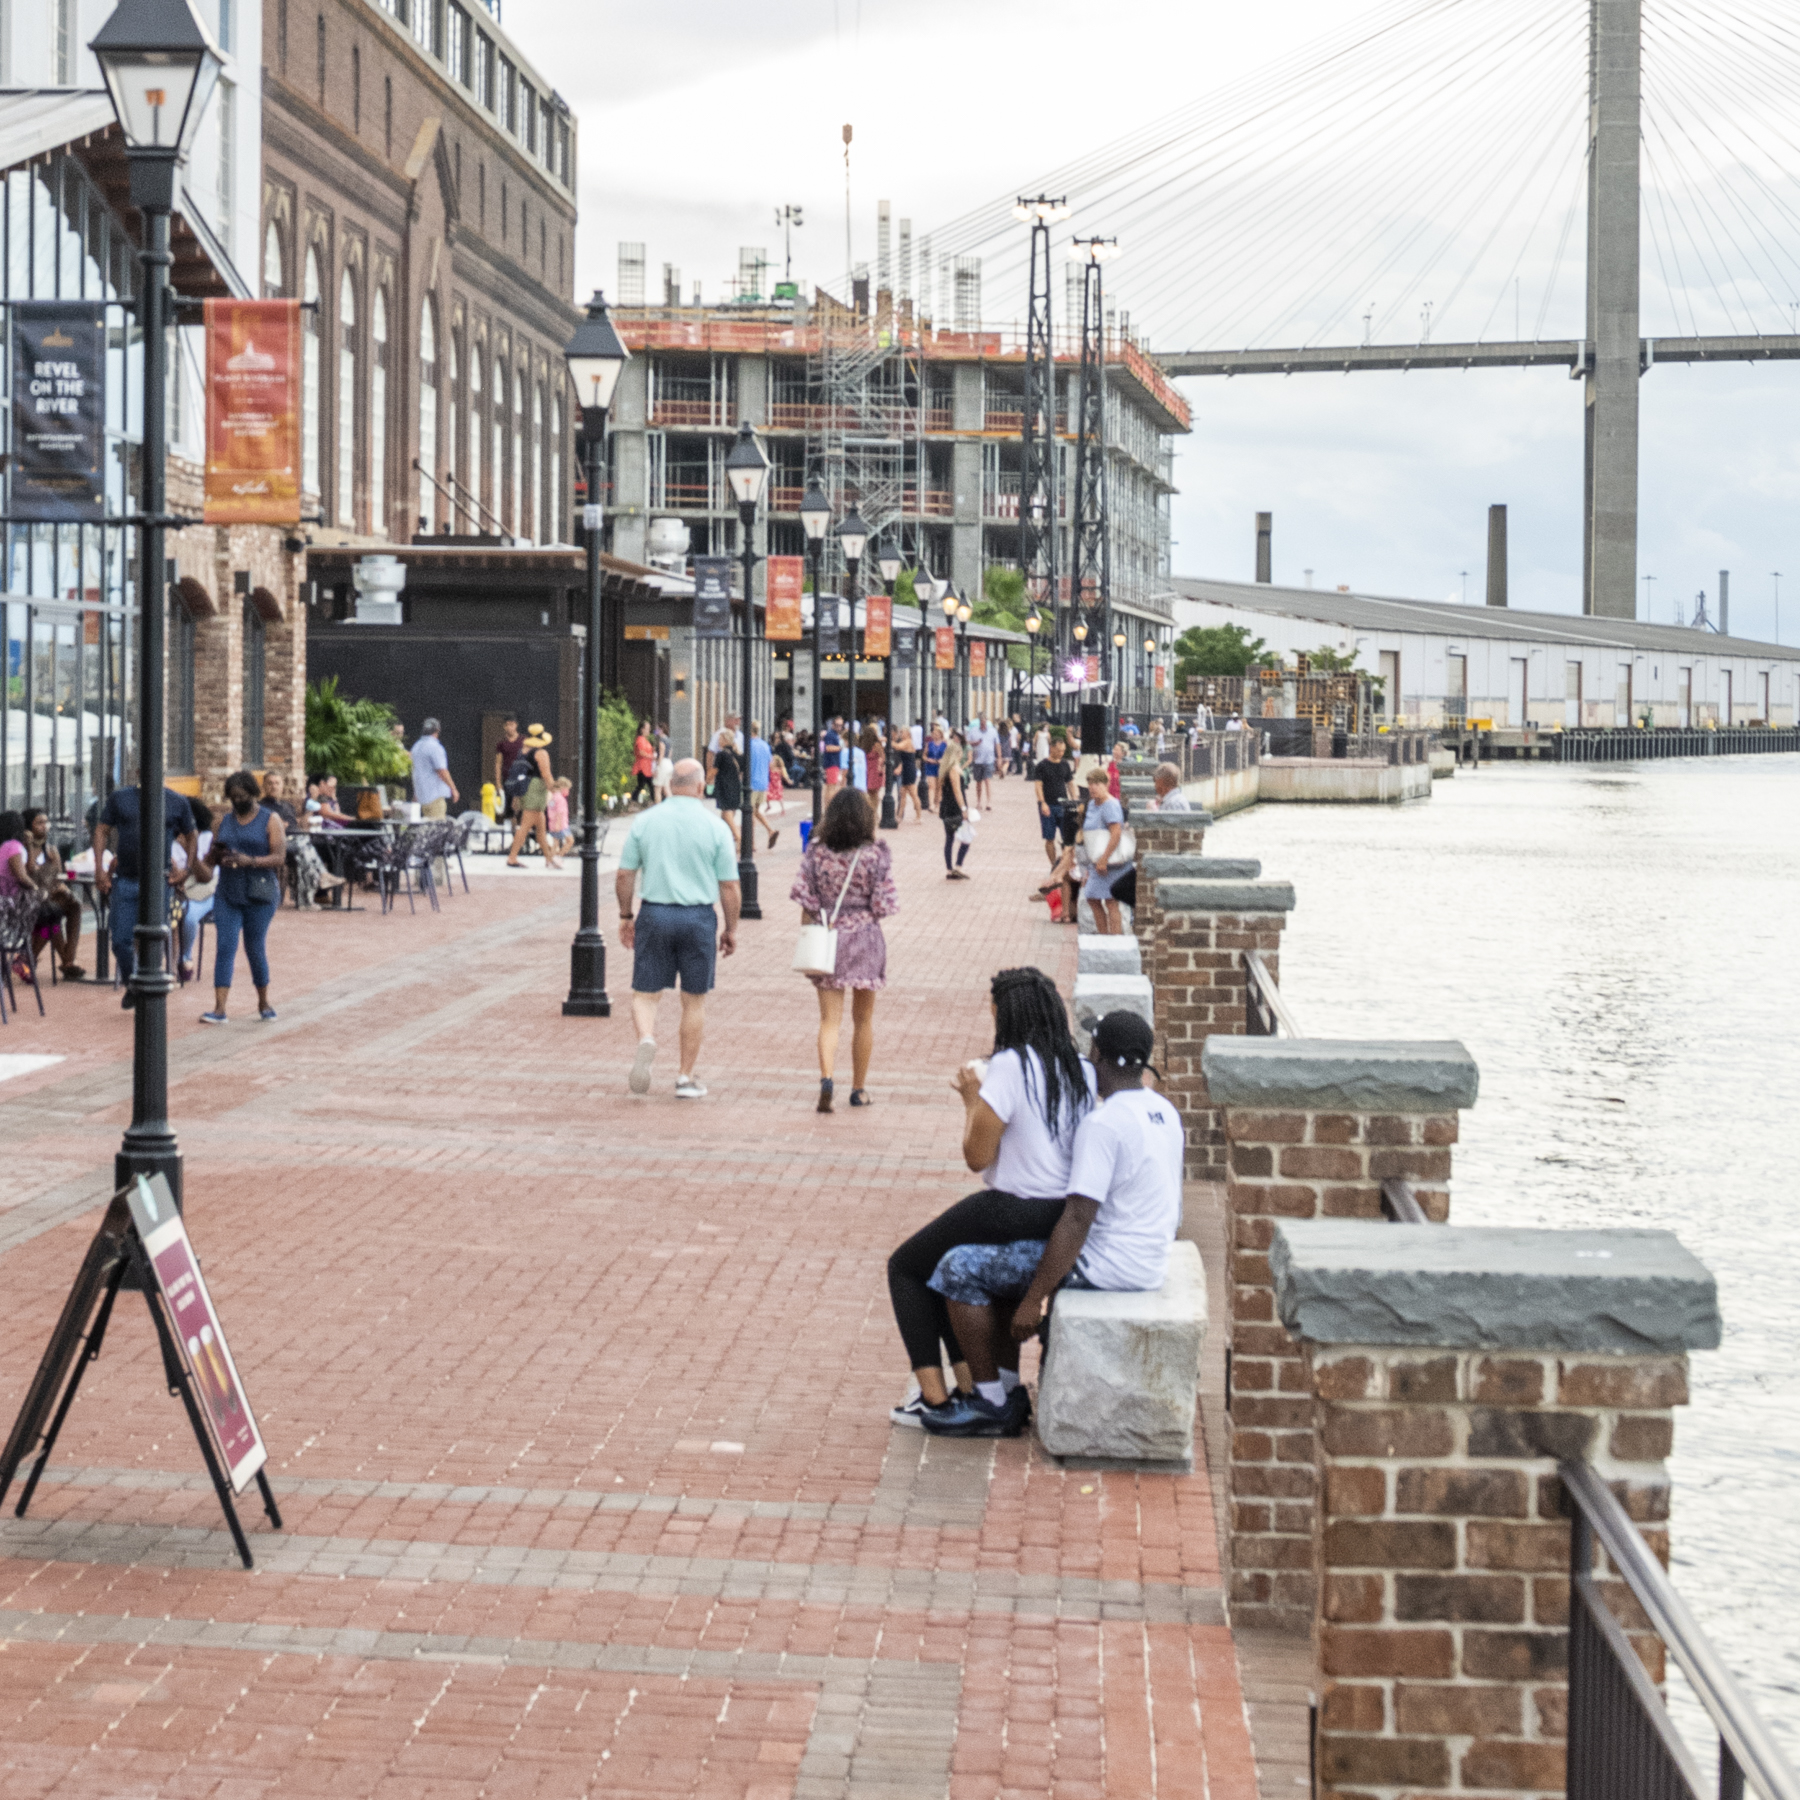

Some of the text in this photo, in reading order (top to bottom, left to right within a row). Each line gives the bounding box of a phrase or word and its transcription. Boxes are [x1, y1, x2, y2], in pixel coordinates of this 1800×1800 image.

[34, 361, 80, 378] REVEL
[29, 379, 84, 396] ON THE
[35, 397, 79, 414] RIVER
